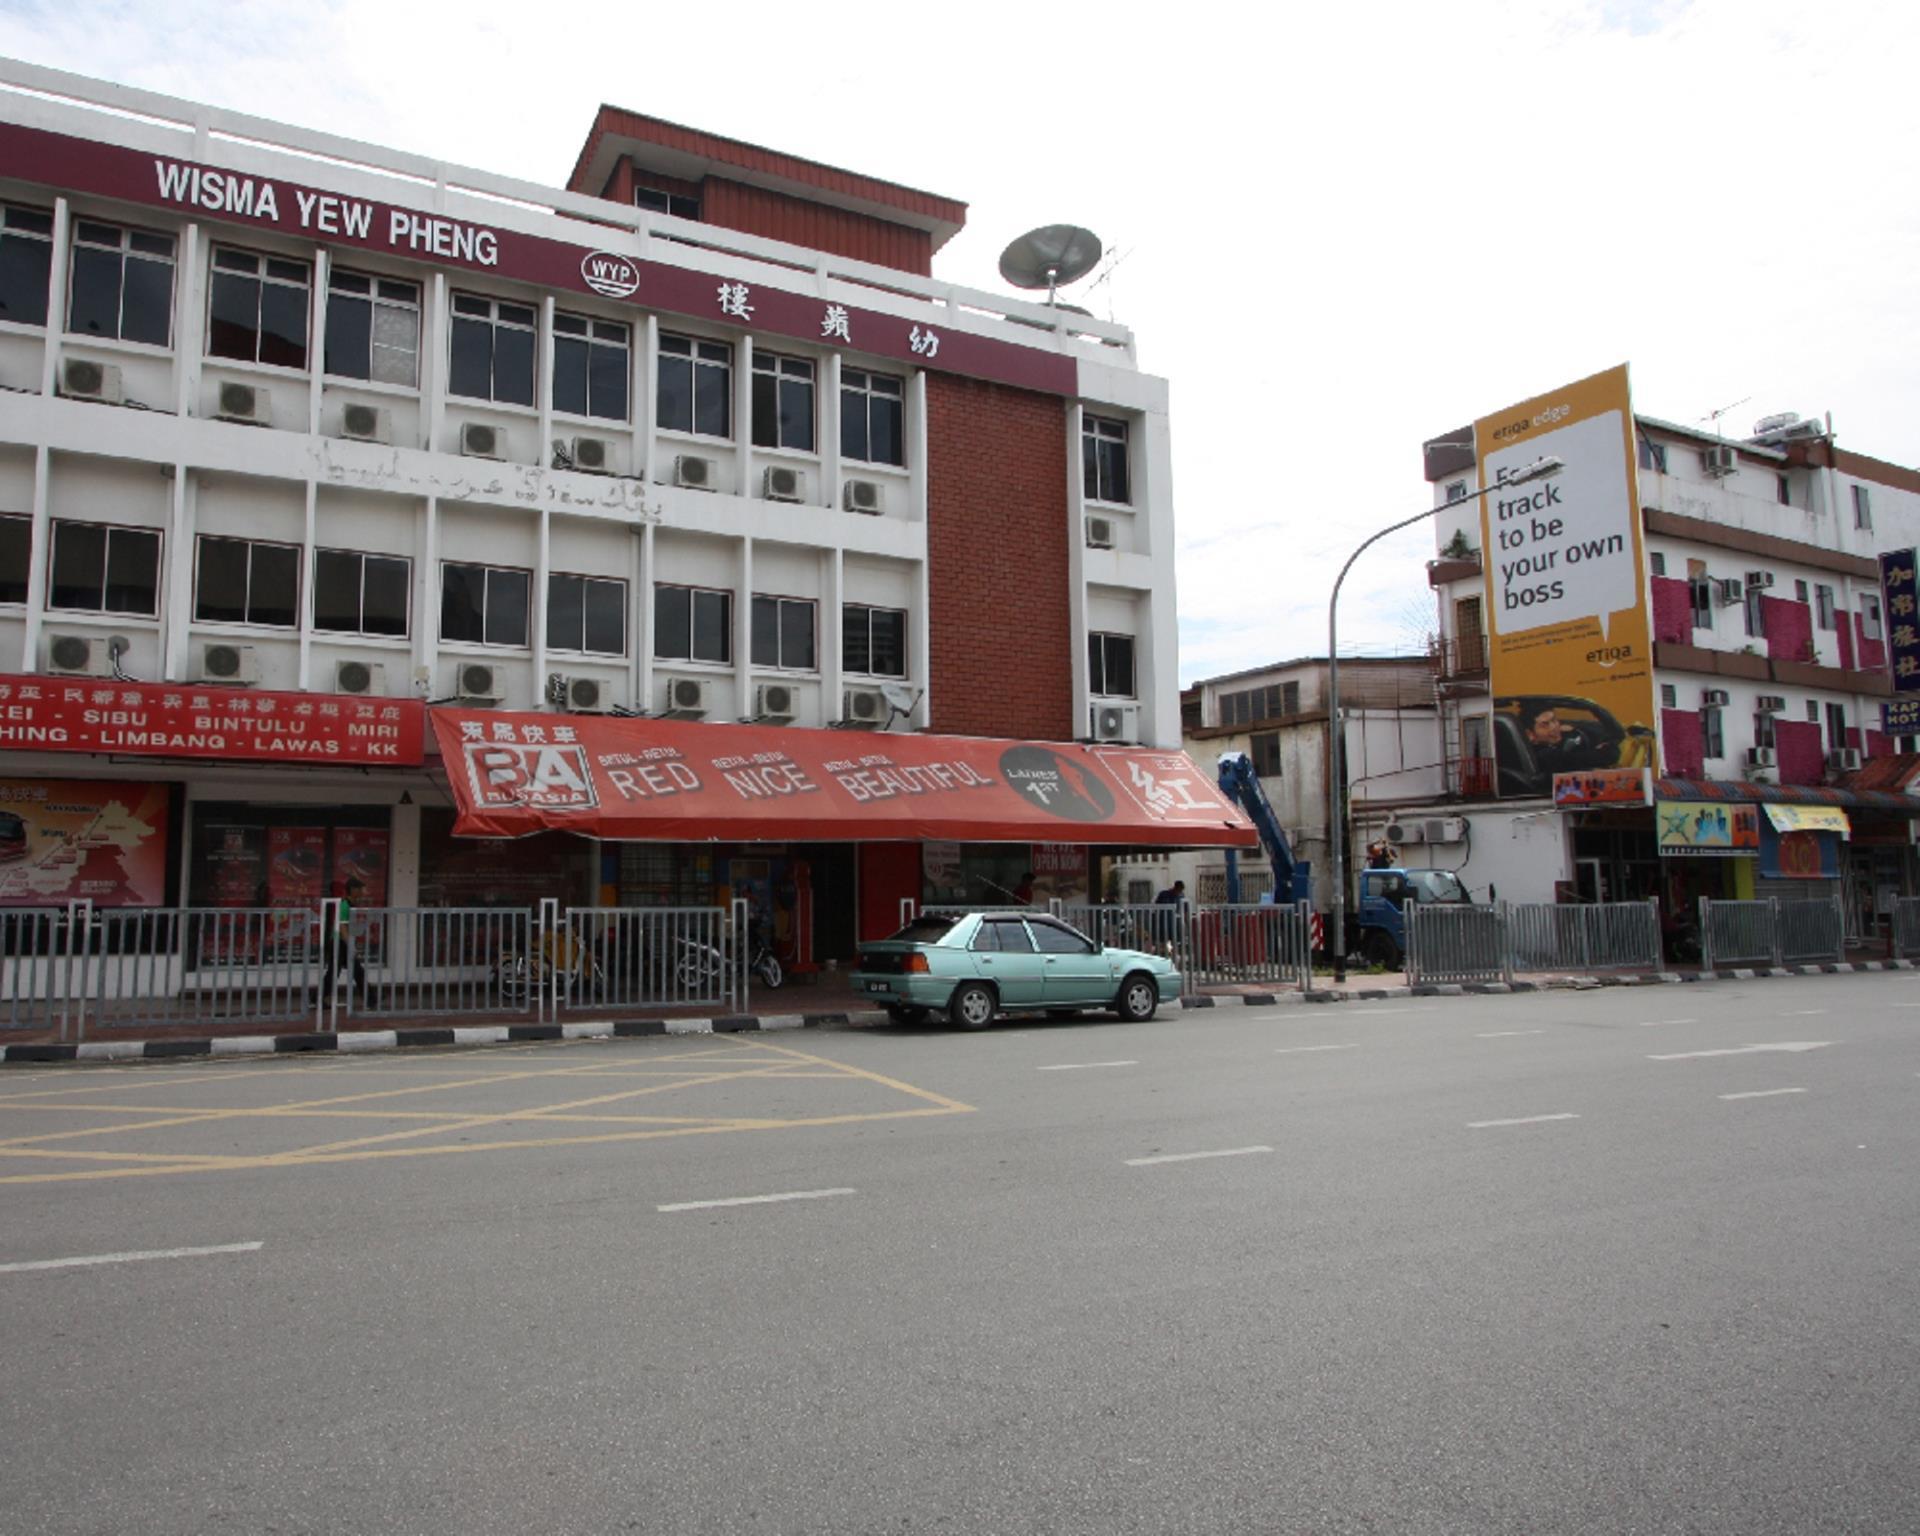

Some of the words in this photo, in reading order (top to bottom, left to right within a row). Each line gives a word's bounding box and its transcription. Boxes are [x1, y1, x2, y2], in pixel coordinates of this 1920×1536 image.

[154, 160, 279, 221] WISMA
[296, 190, 374, 240] YEW
[389, 211, 498, 266] PHENG
[591, 259, 631, 283] WYP
[1532, 403, 1571, 427] edge
[1498, 483, 1562, 520] track
[1499, 528, 1524, 550] to
[1531, 518, 1563, 542] be
[1502, 549, 1558, 585] your
[1565, 534, 1623, 563] own
[1504, 580, 1564, 610] boss
[83, 709, 148, 727] SIBU
[195, 716, 305, 734] BINTULU
[348, 723, 398, 738] MIRI
[100, 730, 225, 750] LIMBANG
[254, 738, 339, 754] LAWAS
[367, 742, 398, 756] KK
[608, 762, 700, 799] RED
[723, 763, 816, 799] NICE
[836, 760, 992, 801] BEAUTIFUL
[1126, 760, 1221, 814] 紅
